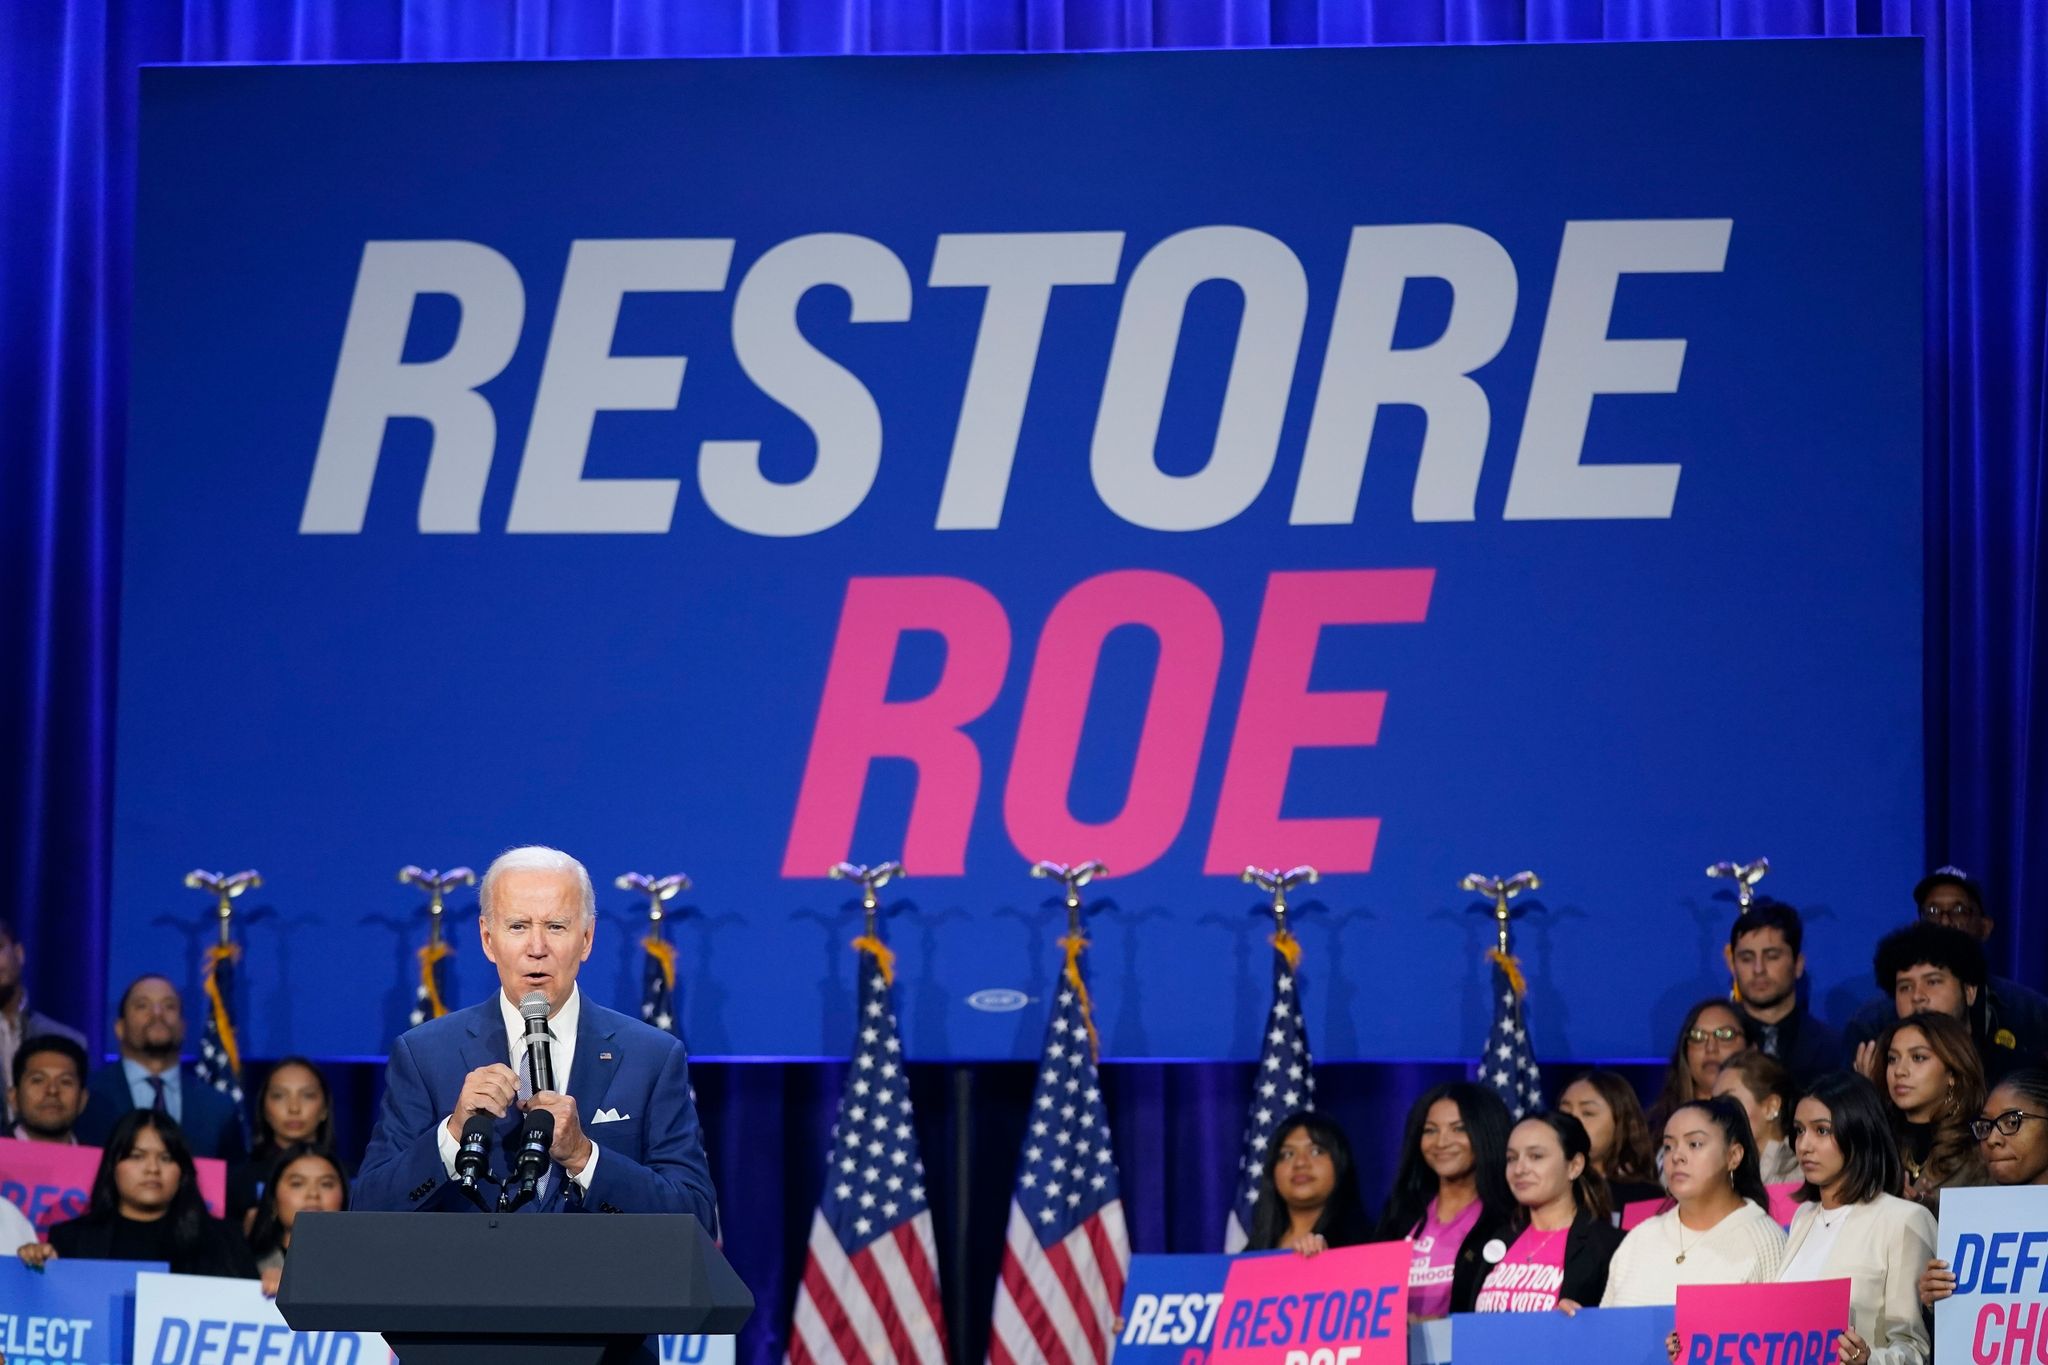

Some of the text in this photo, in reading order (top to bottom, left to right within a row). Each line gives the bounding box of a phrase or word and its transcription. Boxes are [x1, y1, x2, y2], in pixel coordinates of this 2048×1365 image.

[301, 220, 1732, 536] RESTORE
[781, 569, 1435, 878] ROE
[1222, 1286, 1399, 1349] RESTORE
